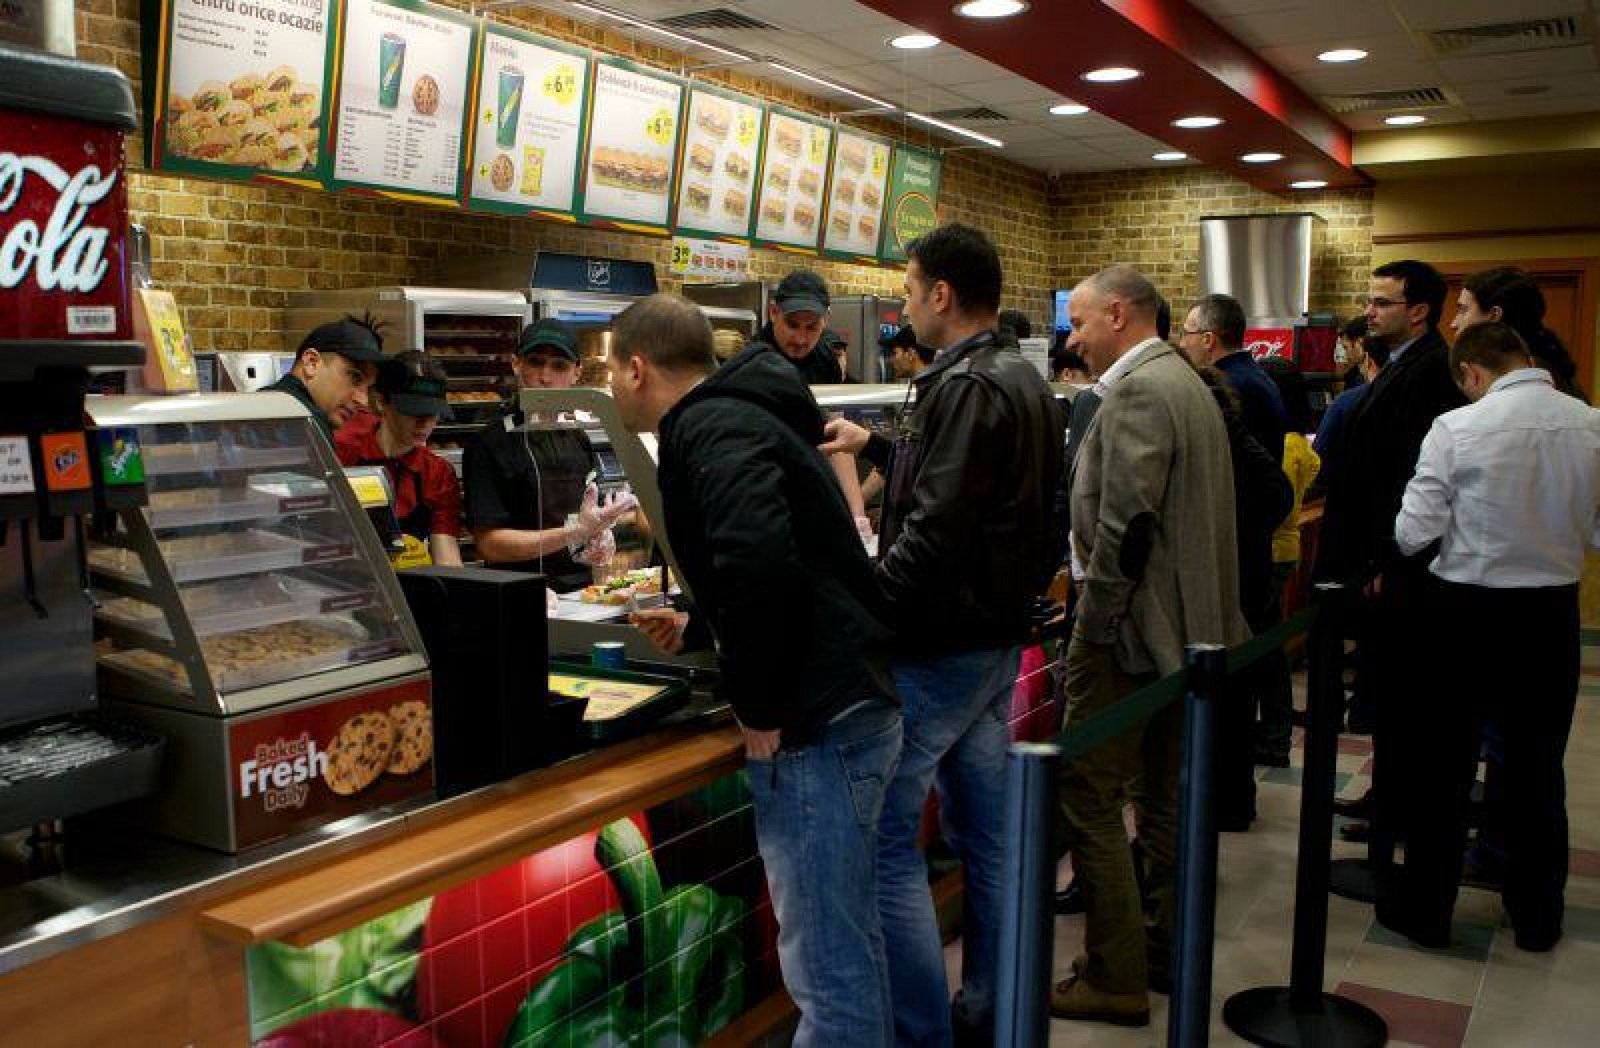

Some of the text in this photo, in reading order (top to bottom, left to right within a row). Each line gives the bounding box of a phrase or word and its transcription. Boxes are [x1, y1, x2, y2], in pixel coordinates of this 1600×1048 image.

[239, 2, 277, 22] orice
[279, 11, 323, 33] ocazie
[255, 731, 310, 766] Baked
[239, 739, 329, 798] Fresh
[263, 782, 311, 813] Daily
